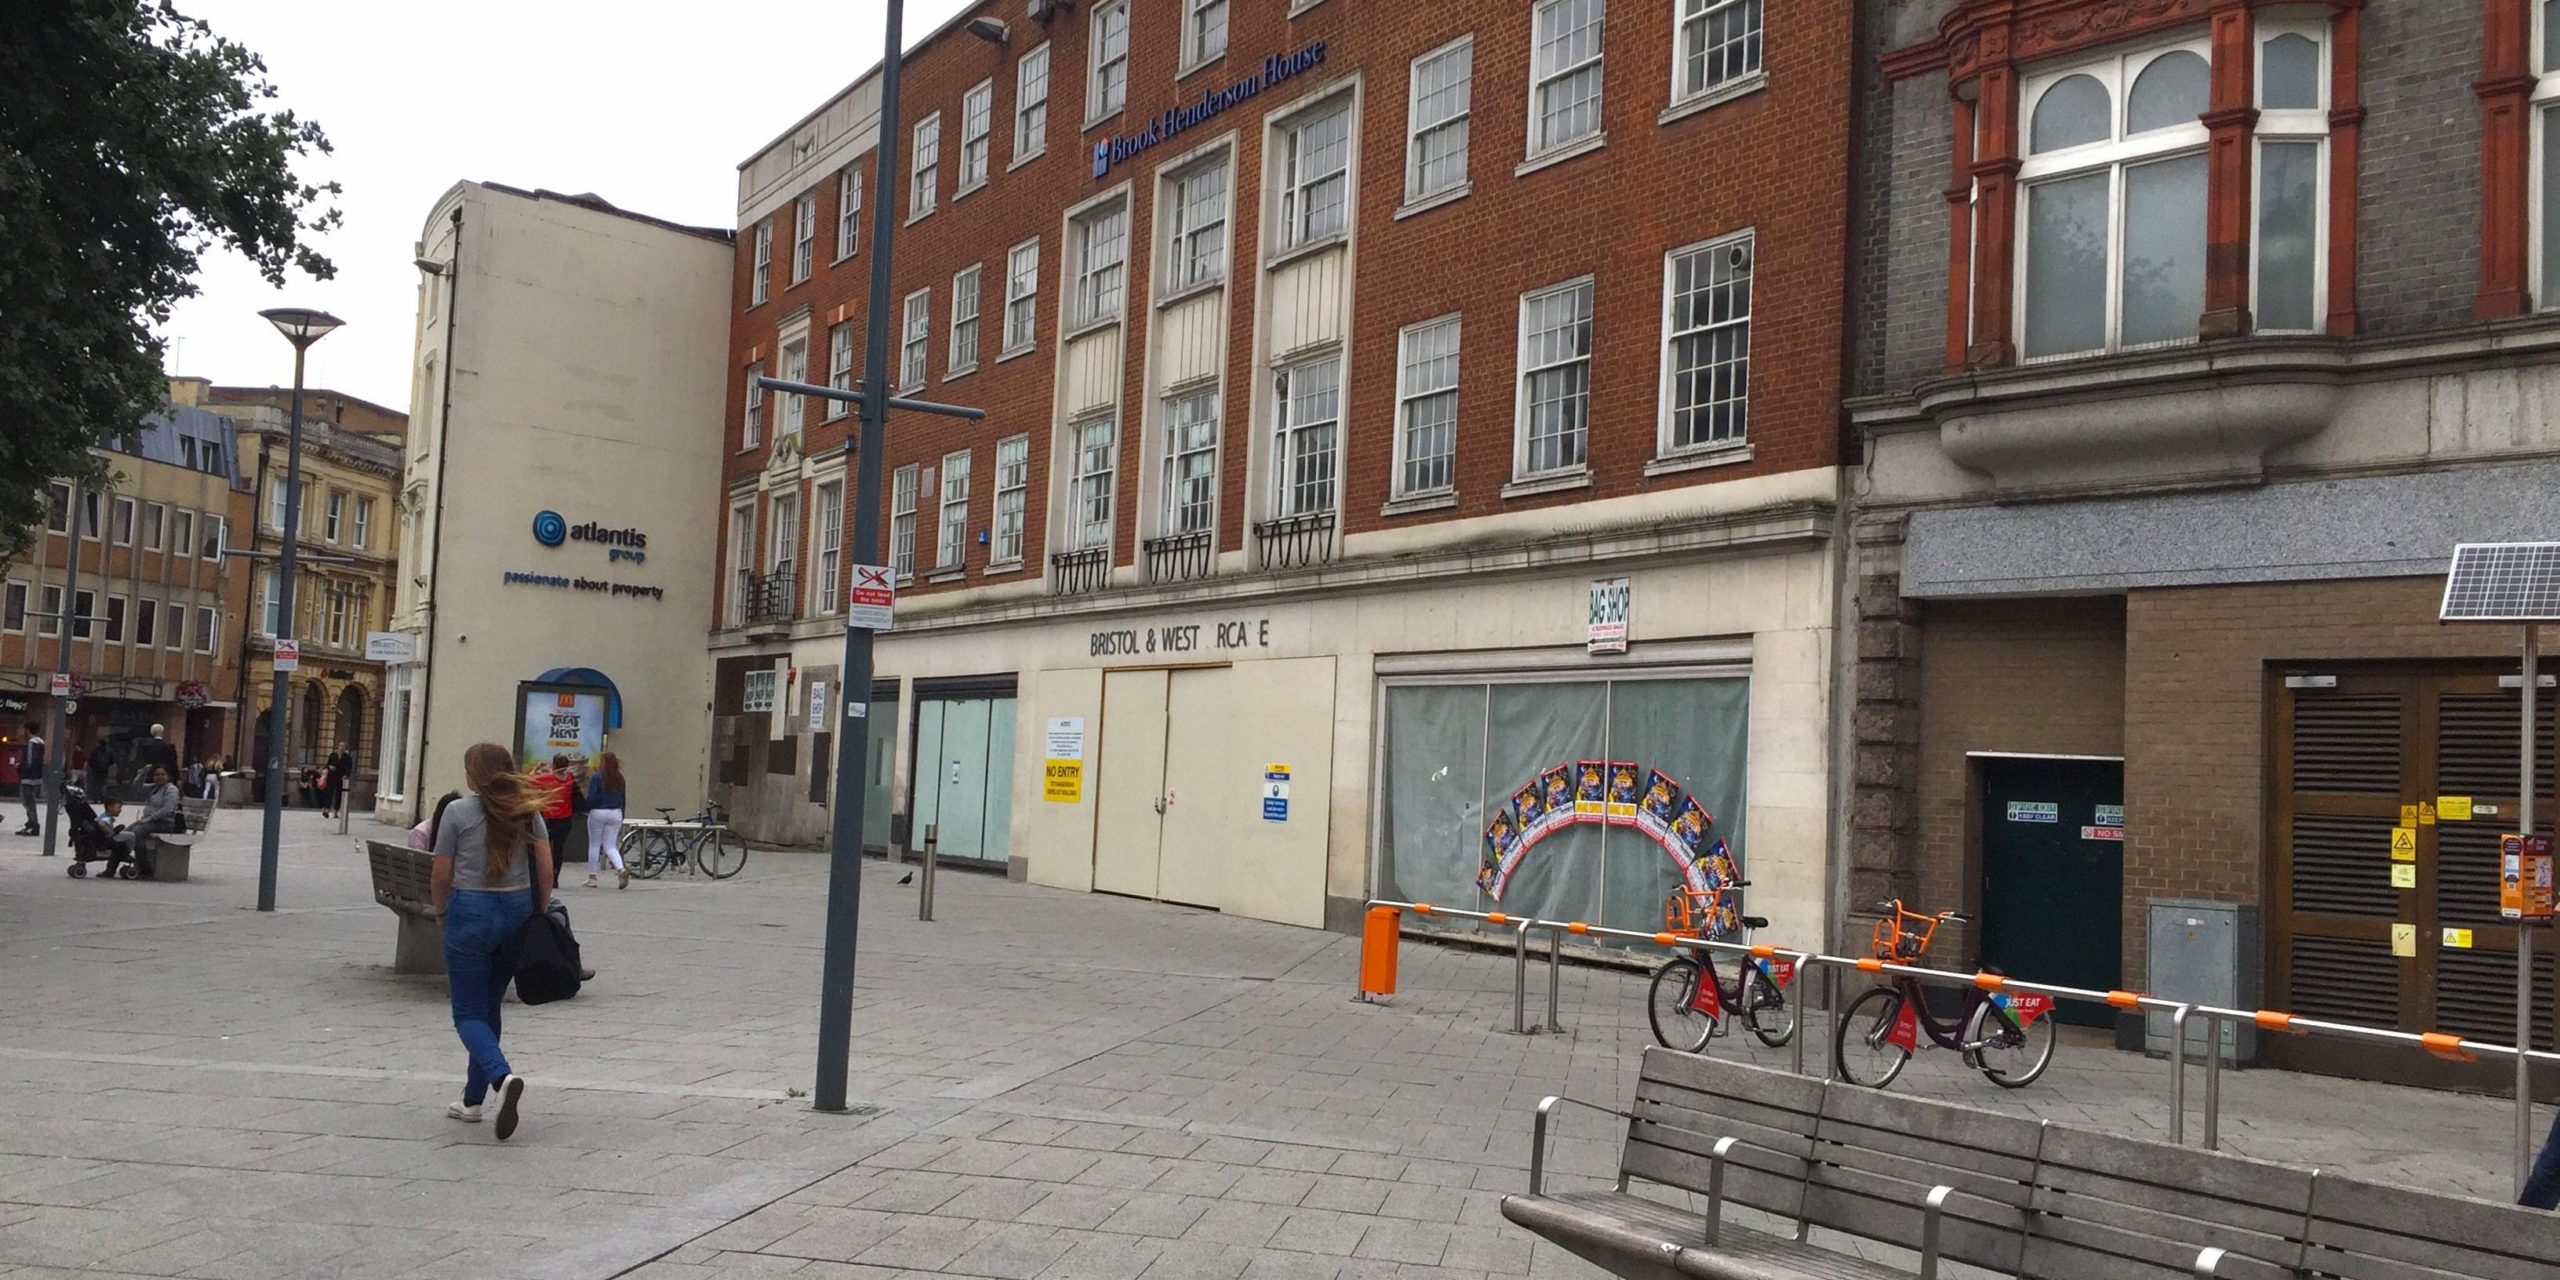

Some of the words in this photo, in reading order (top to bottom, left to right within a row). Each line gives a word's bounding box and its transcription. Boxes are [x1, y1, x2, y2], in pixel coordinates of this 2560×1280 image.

[1112, 117, 1161, 165] Brook
[1161, 73, 1260, 139] Henderson
[1261, 40, 1327, 90] House
[570, 521, 647, 548] atlantis
[608, 548, 645, 565] group
[503, 571, 570, 589] passionate
[573, 576, 609, 592] about
[611, 582, 664, 601] property
[1589, 588, 1606, 625] BAG
[1607, 586, 1630, 623] SHOP
[1090, 630, 1140, 657] BRISTOL
[1145, 628, 1156, 653] &
[1162, 625, 1200, 651] WEST
[549, 713, 581, 727] TREAT
[549, 726, 581, 739] HEAT
[1046, 765, 1057, 778] NO
[1058, 766, 1080, 778] ENTRY
[1780, 963, 1790, 972] EAT
[2005, 997, 2023, 1008] JUST
[2025, 997, 2042, 1007] EAT
